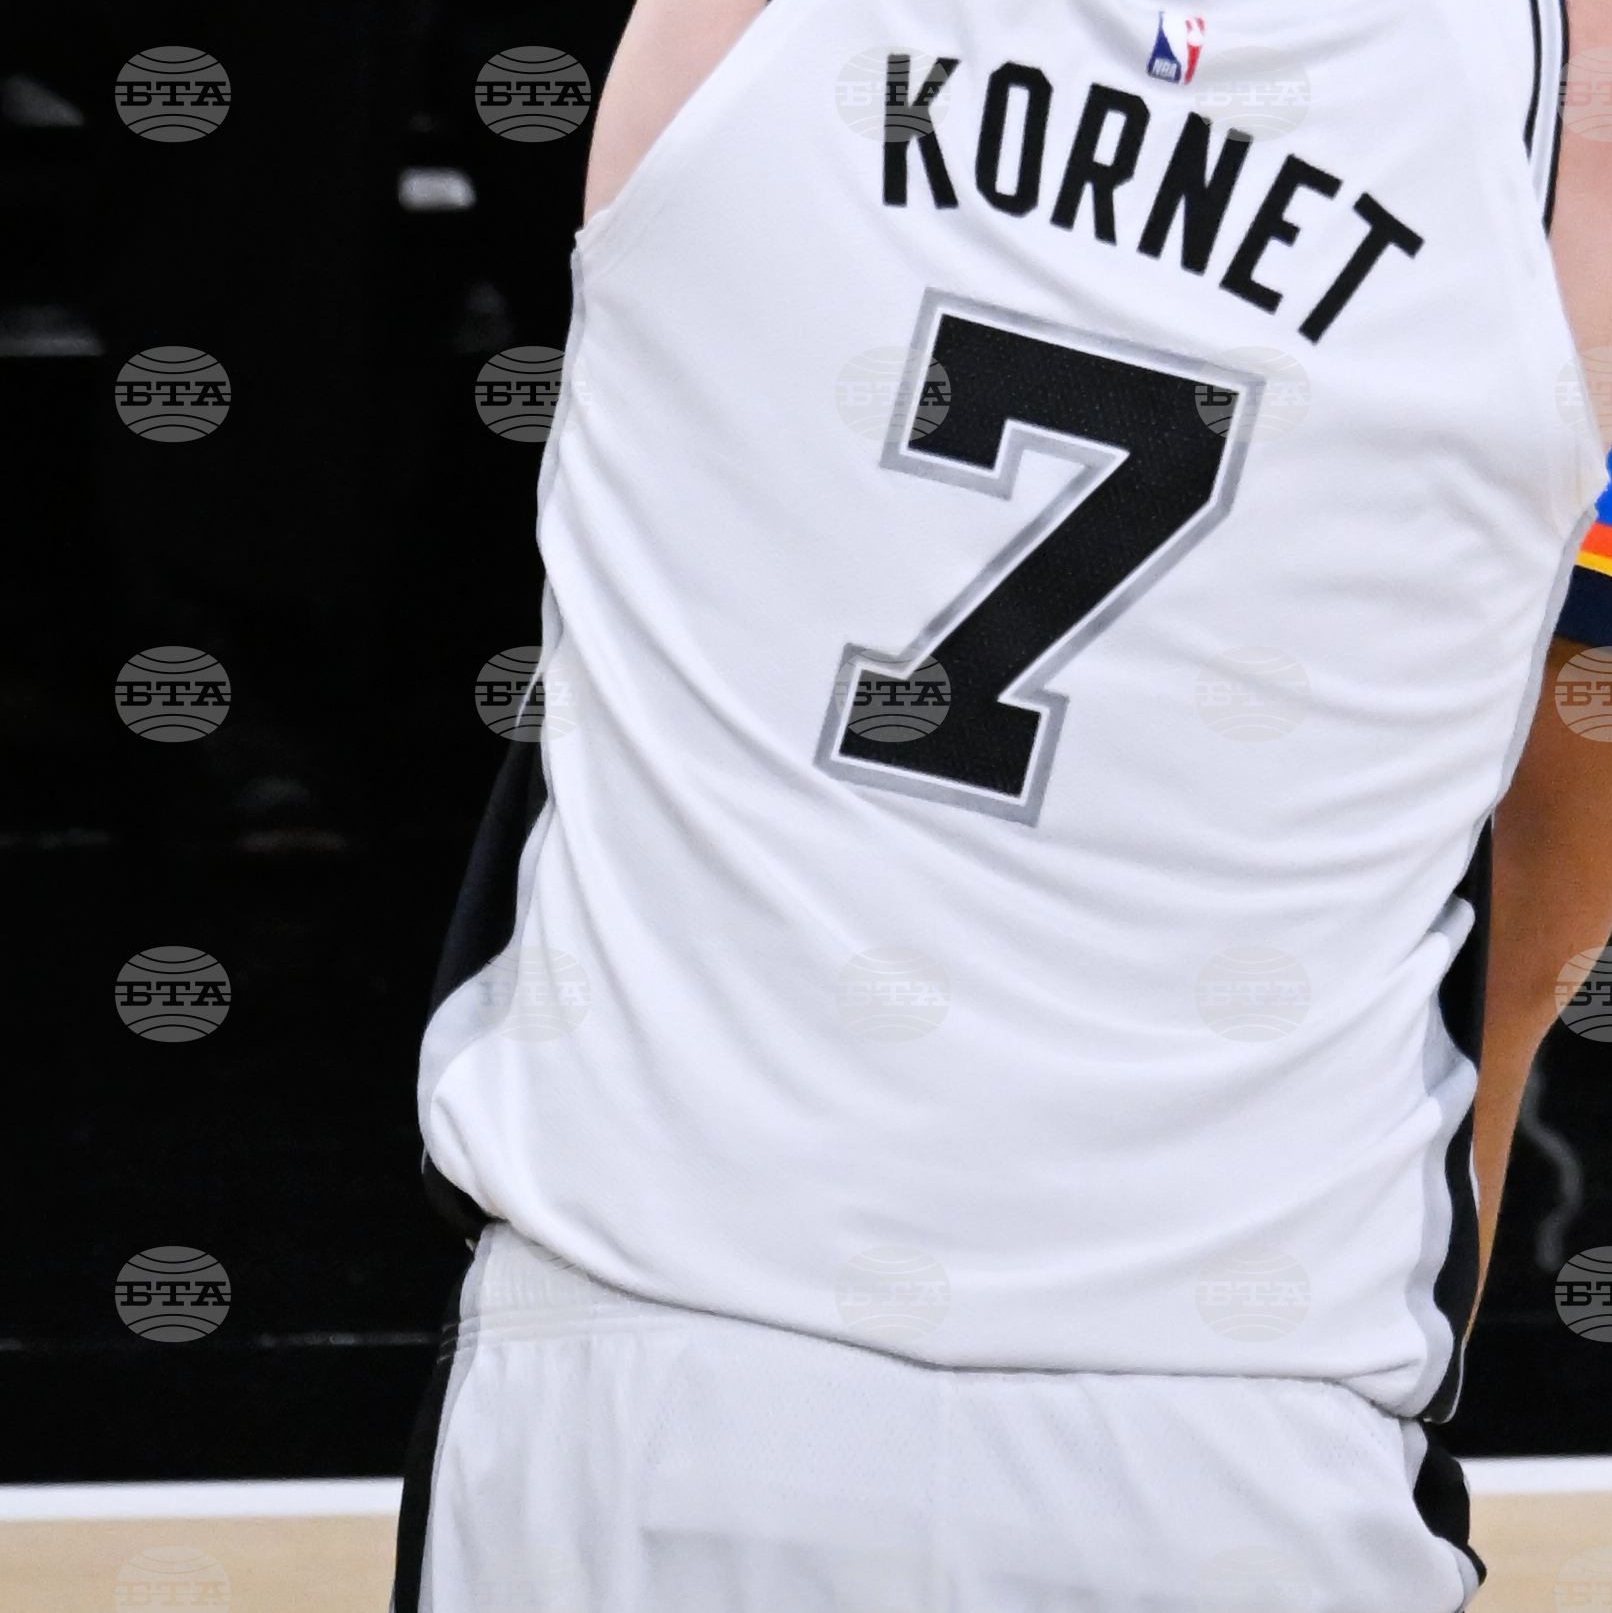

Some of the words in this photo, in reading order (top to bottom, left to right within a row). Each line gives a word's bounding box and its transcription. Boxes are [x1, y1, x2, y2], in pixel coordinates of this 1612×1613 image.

[881, 51, 1424, 345] KORNET
[1151, 59, 1178, 79] NBA
[813, 287, 1266, 828] 7
